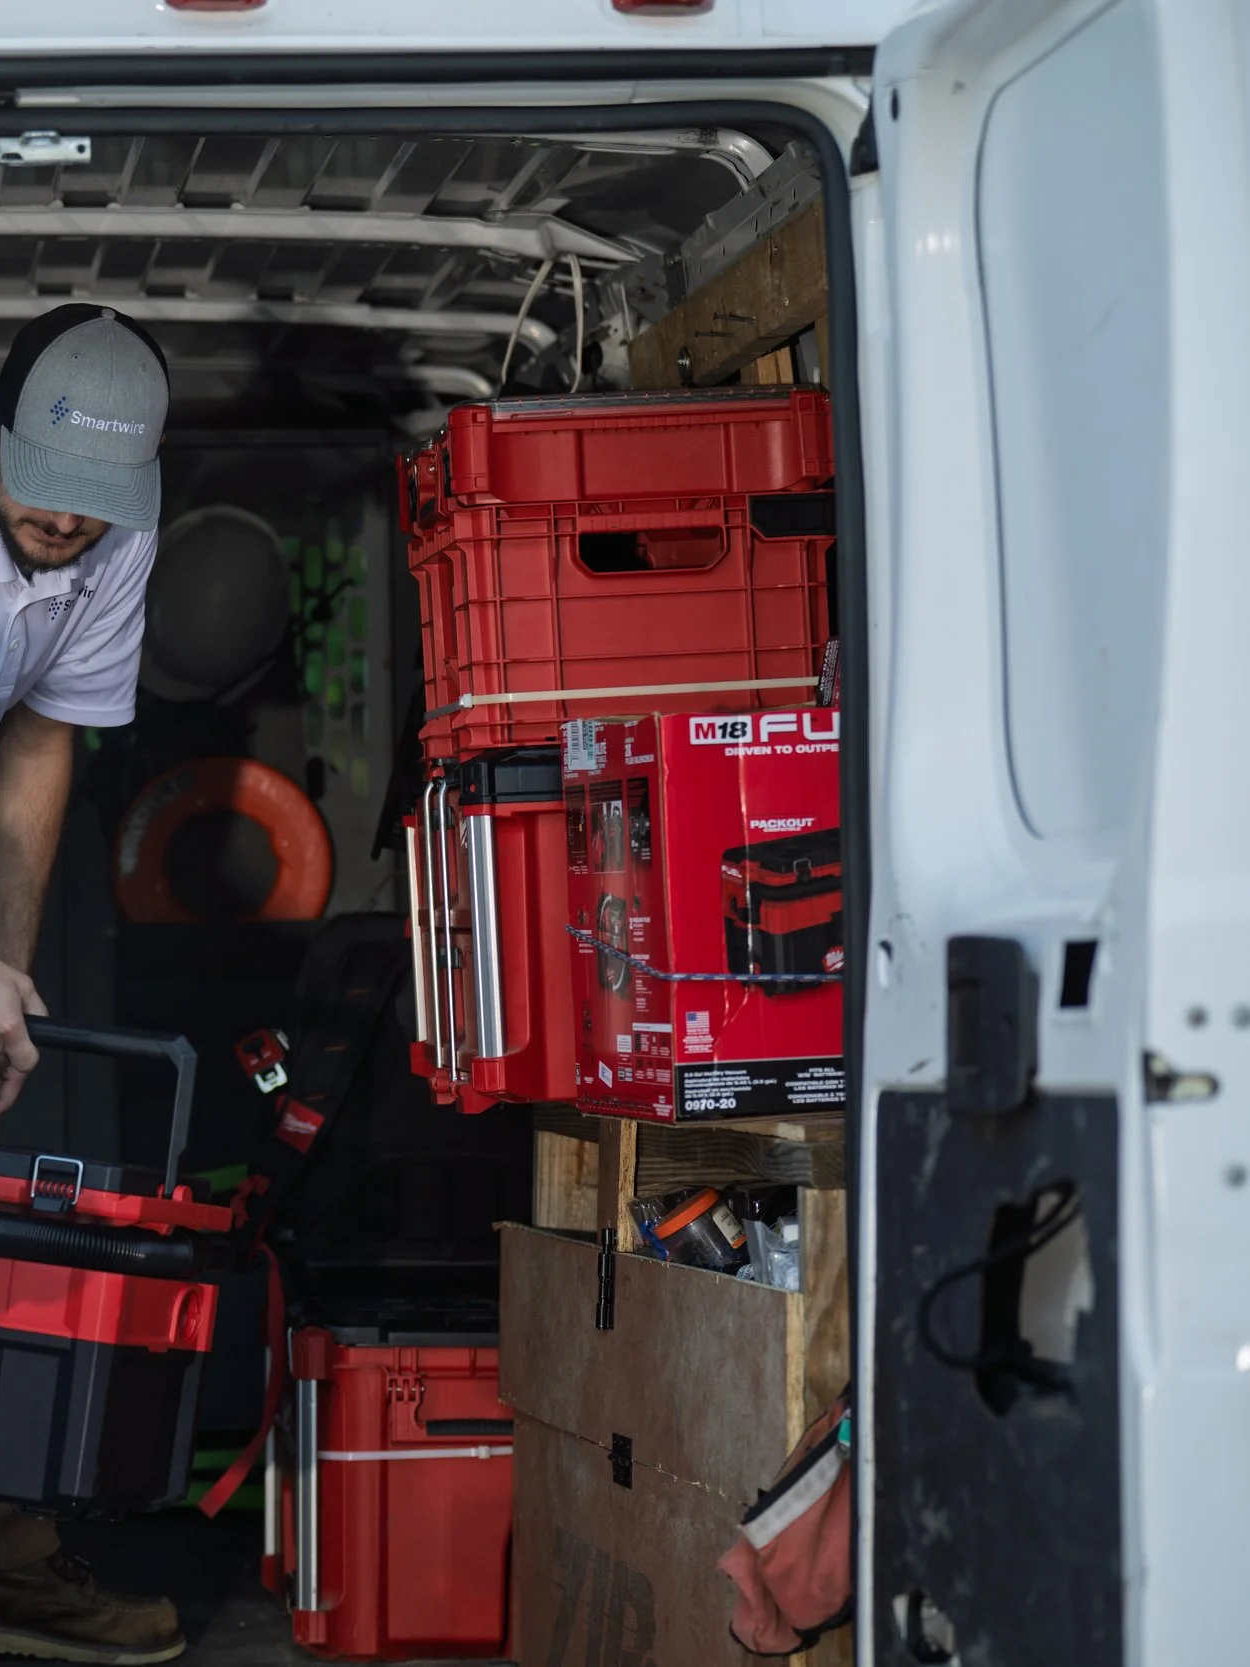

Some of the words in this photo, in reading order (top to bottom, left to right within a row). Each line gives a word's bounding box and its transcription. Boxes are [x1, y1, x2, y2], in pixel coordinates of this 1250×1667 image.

[70, 410, 145, 434] Smartwire
[694, 721, 748, 740] M18
[724, 745, 772, 757] DRIVEN
[774, 744, 793, 755] TO
[750, 817, 815, 829] PACKOUT
[684, 1098, 737, 1112] 0970-20
